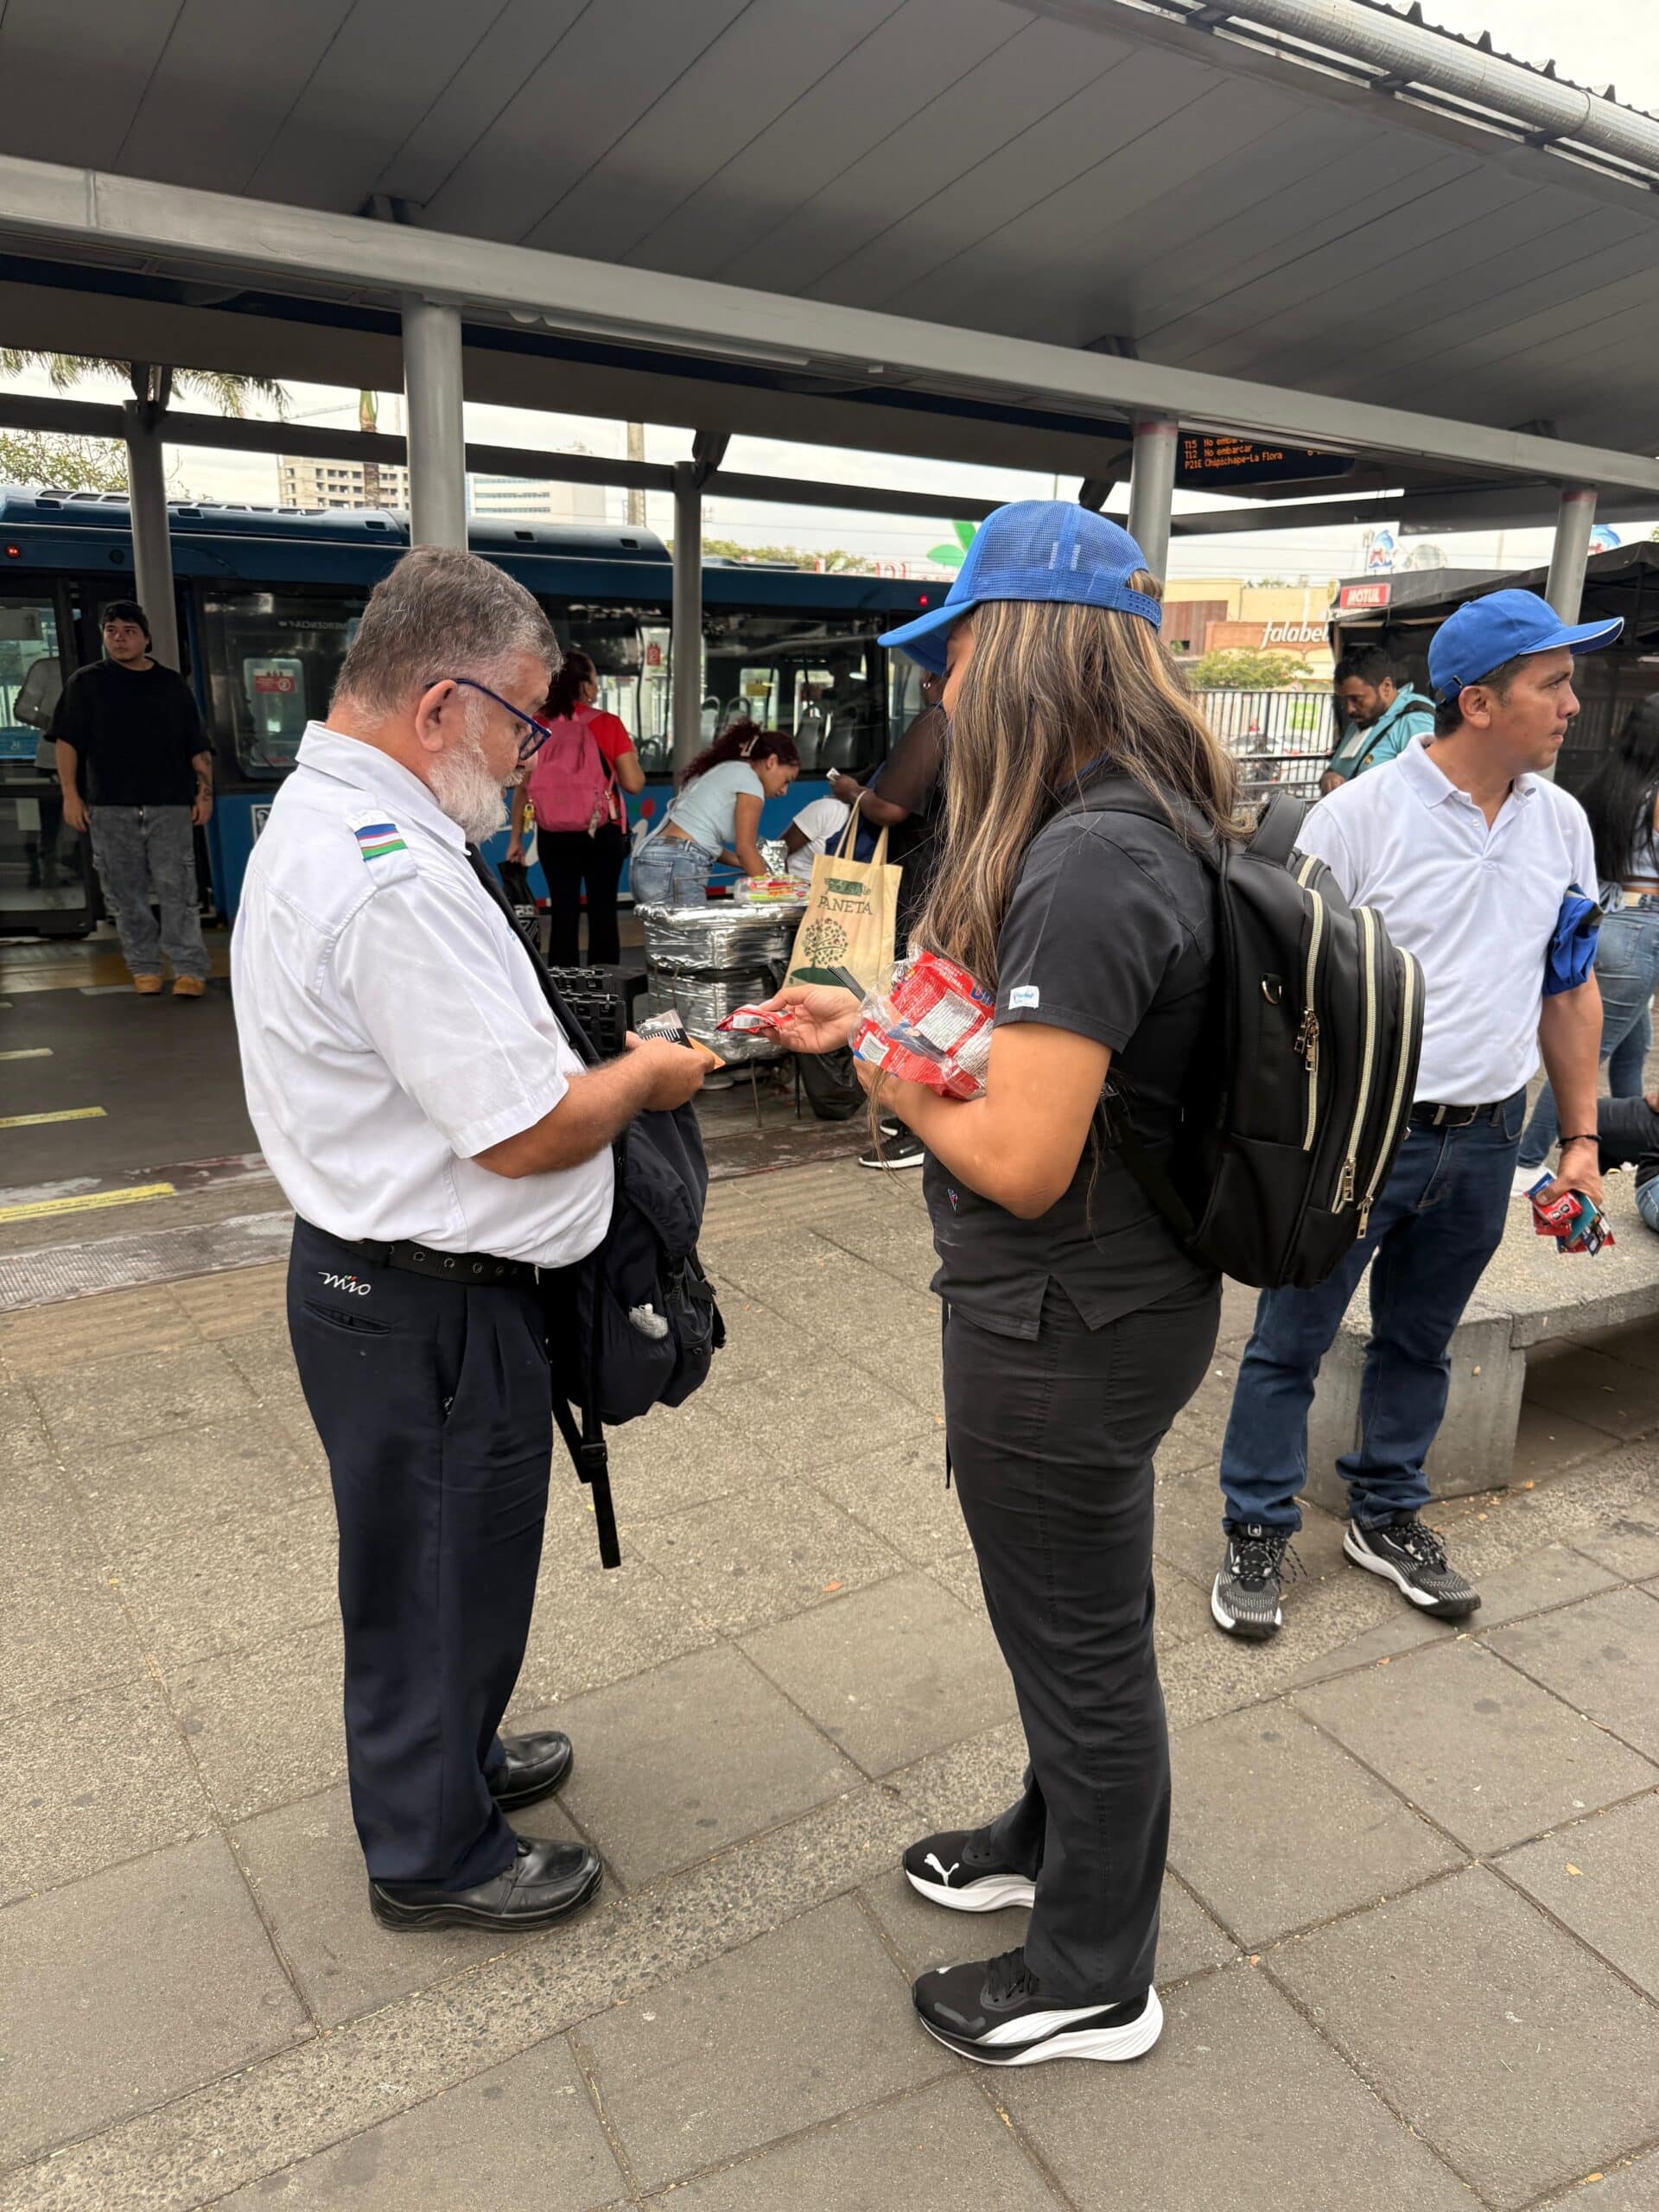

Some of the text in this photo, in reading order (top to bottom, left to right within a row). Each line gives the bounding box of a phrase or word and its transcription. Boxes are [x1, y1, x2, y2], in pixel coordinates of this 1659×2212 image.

[1184, 440, 1198, 449] T15
[1204, 438, 1214, 448] No
[1185, 445, 1253, 460] T12 No embarcar
[1262, 450, 1283, 461] Flora
[1346, 587, 1380, 606] MOTUL
[1259, 620, 1329, 651] falabel
